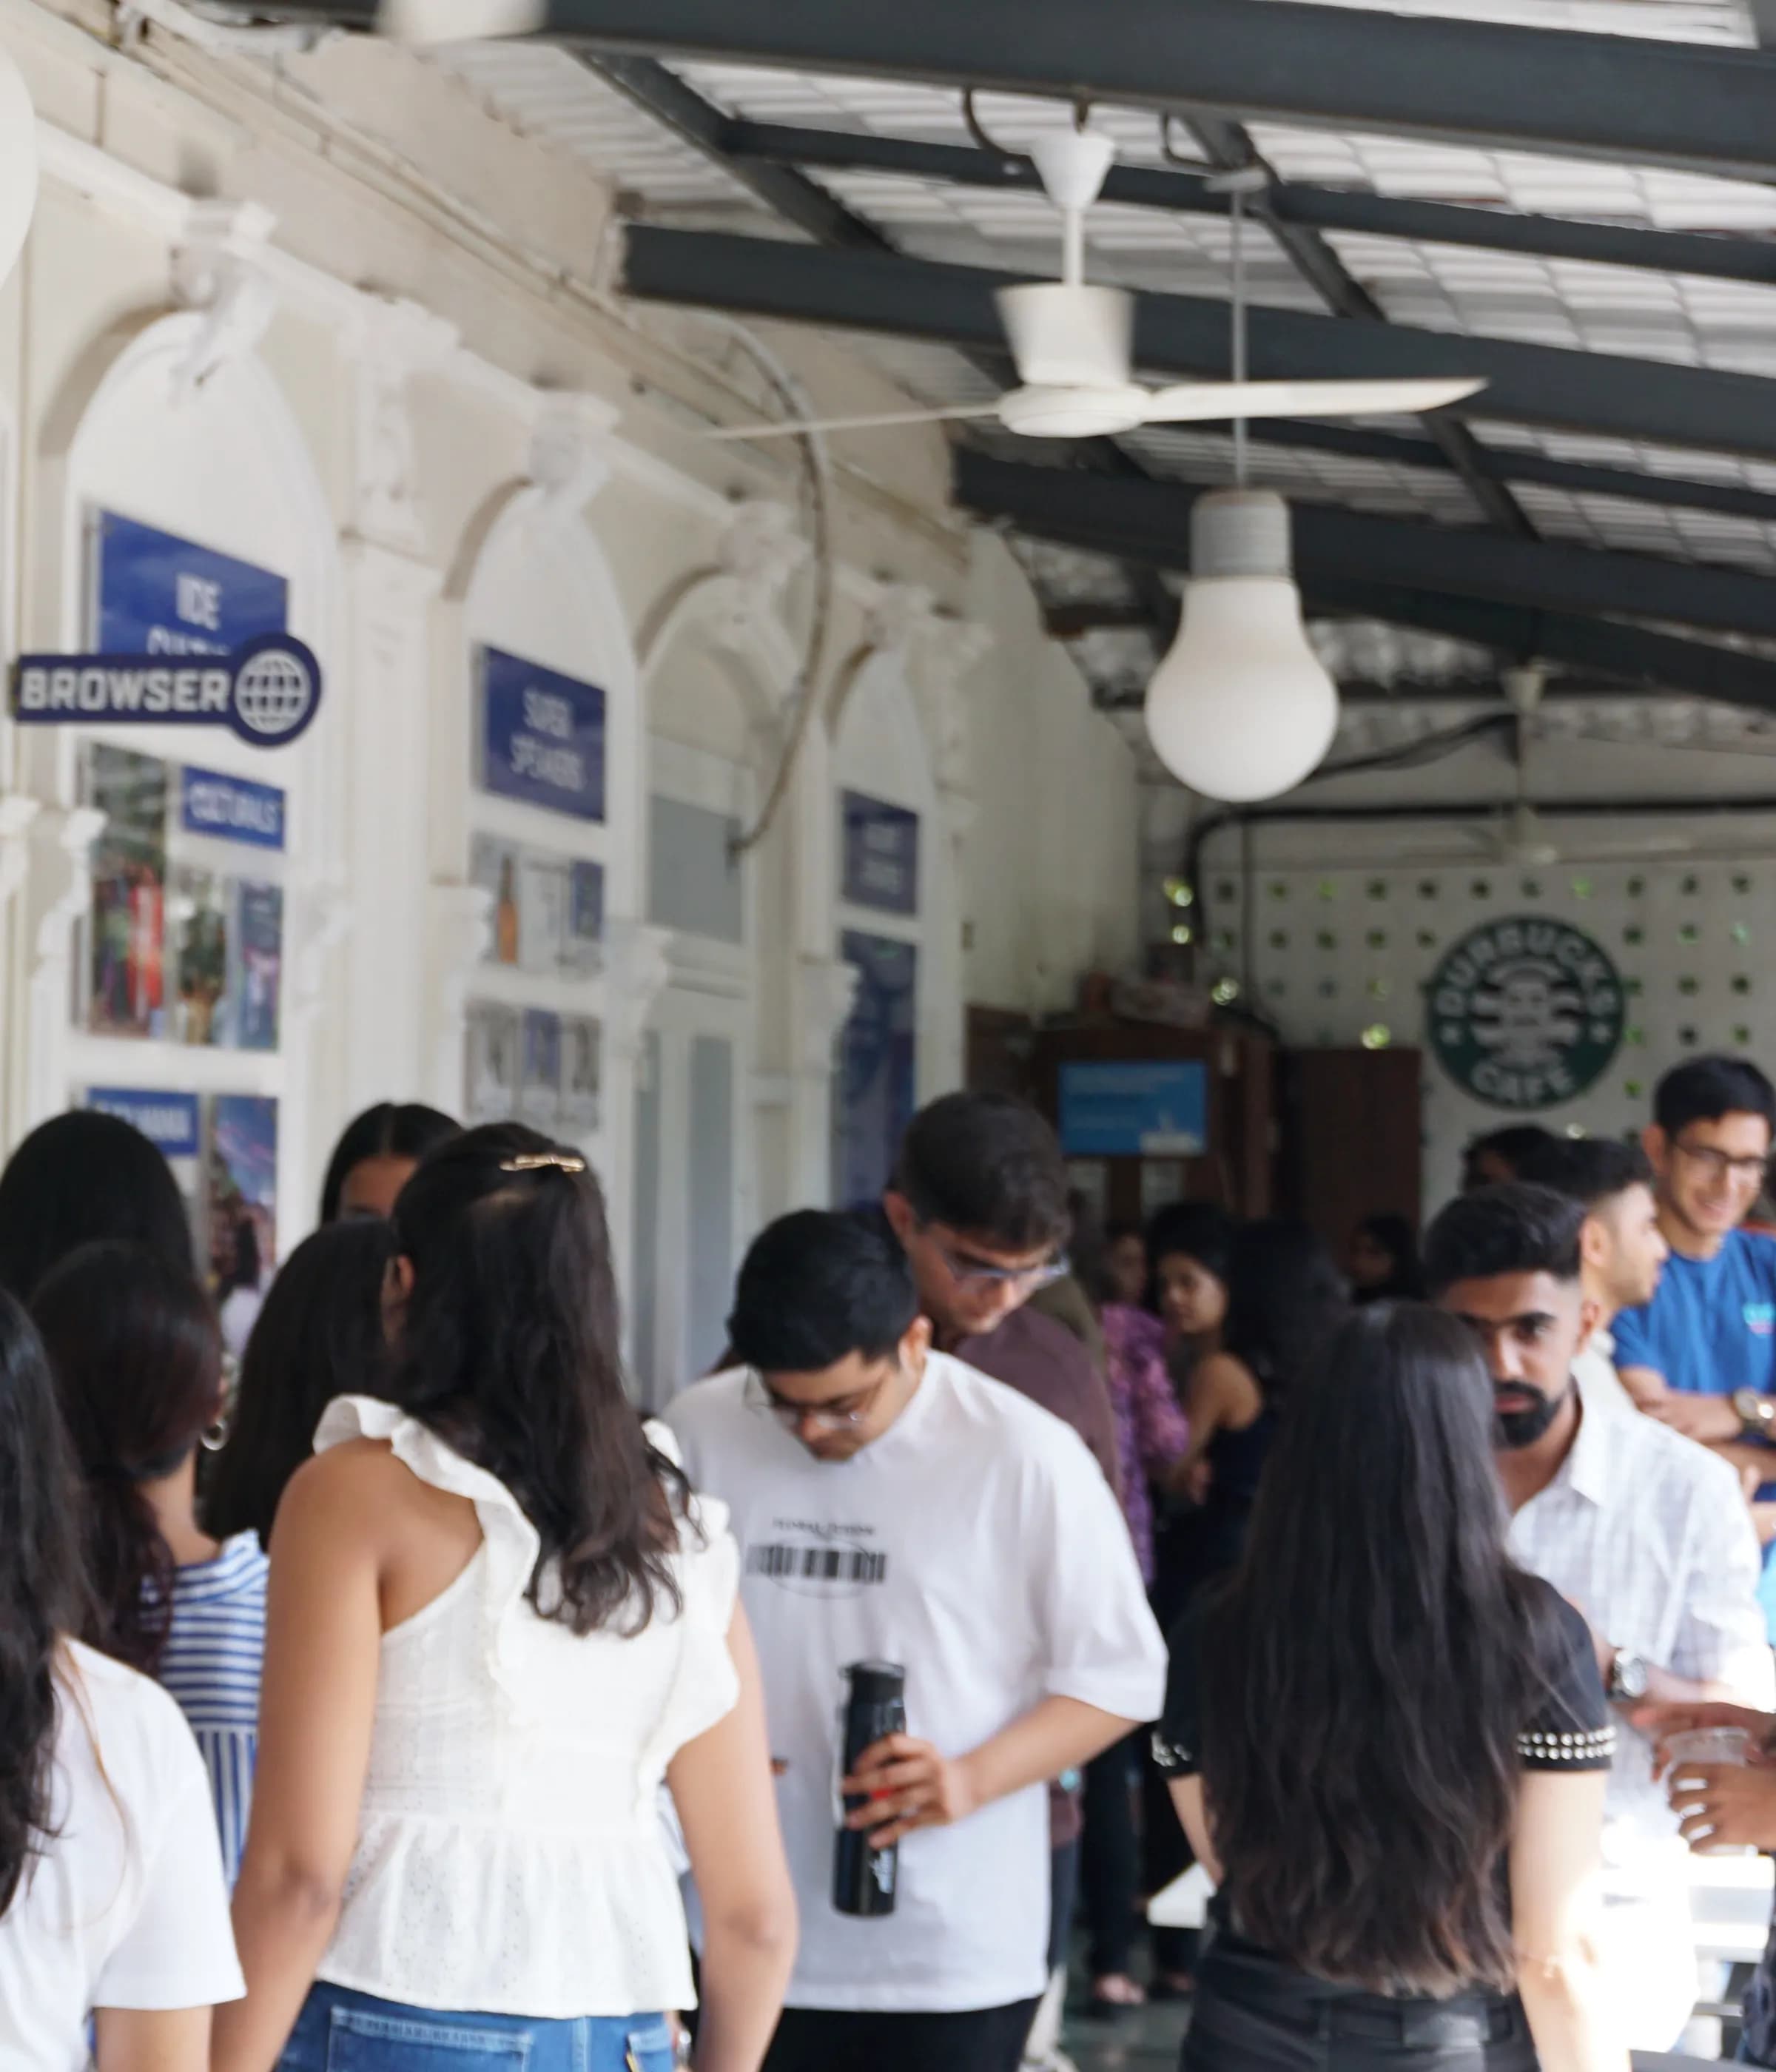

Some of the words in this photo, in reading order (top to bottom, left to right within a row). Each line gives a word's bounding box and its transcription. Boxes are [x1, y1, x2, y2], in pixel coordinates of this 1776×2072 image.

[21, 668, 231, 713] BROWSER
[1436, 924, 1617, 1018] DURBUCKS
[1470, 1059, 1575, 1103] CAFE
